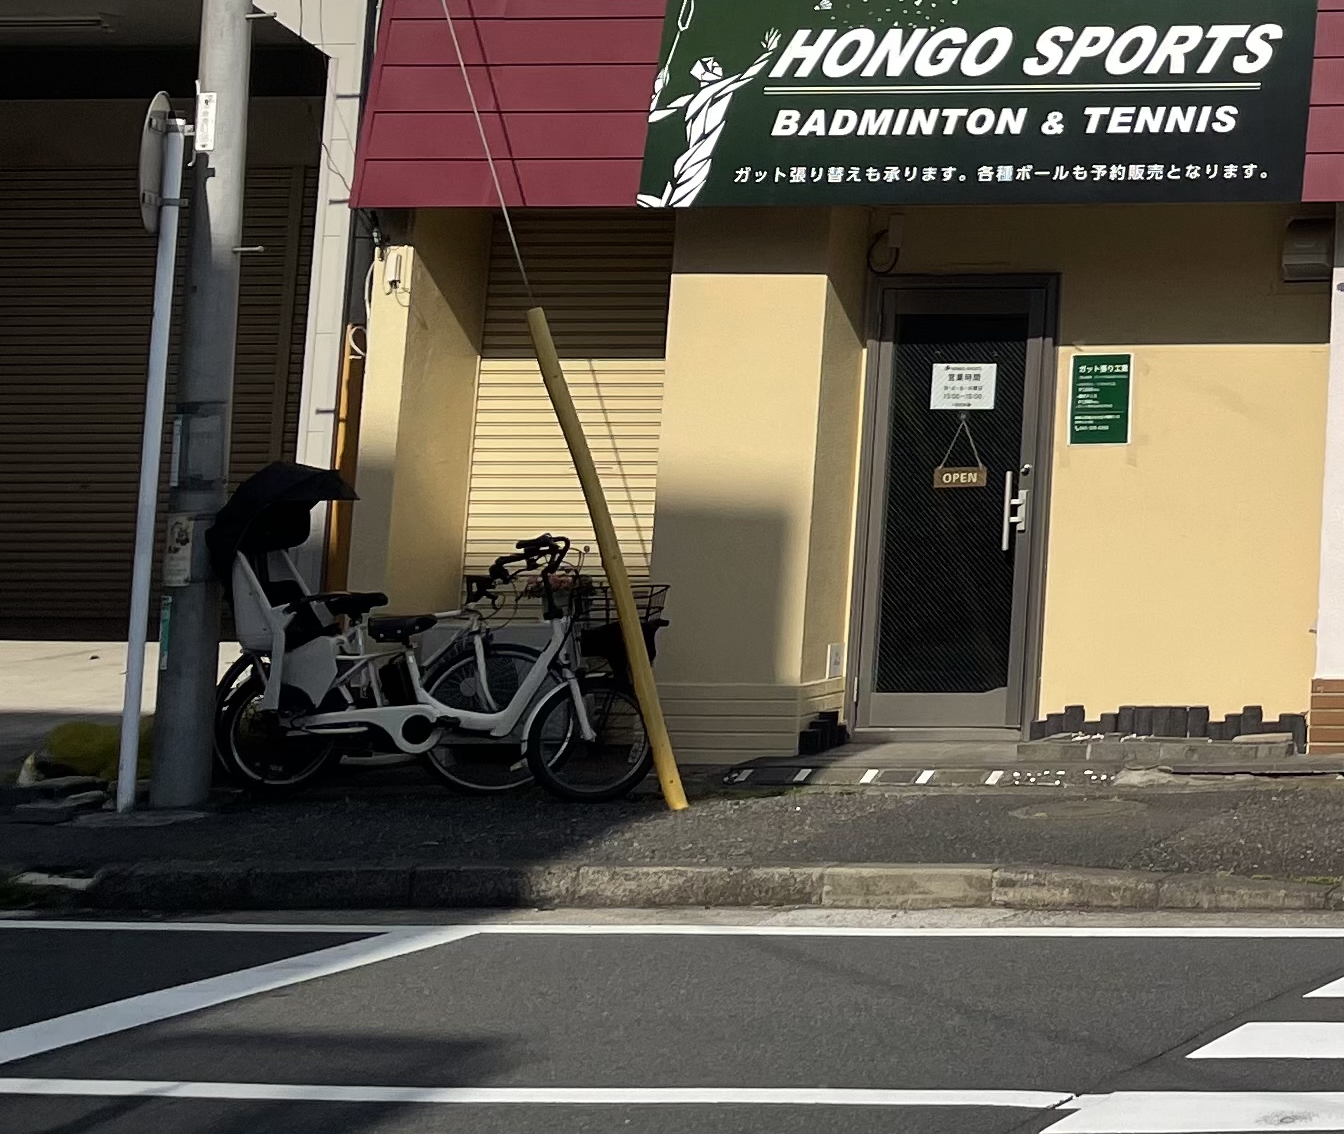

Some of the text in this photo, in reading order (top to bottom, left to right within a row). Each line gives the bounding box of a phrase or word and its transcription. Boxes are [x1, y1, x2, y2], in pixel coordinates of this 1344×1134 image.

[770, 23, 1284, 78] HONGO SPORTS
[771, 105, 1239, 137] BADMINTON & TENNIS
[942, 472, 978, 484] OPEN
